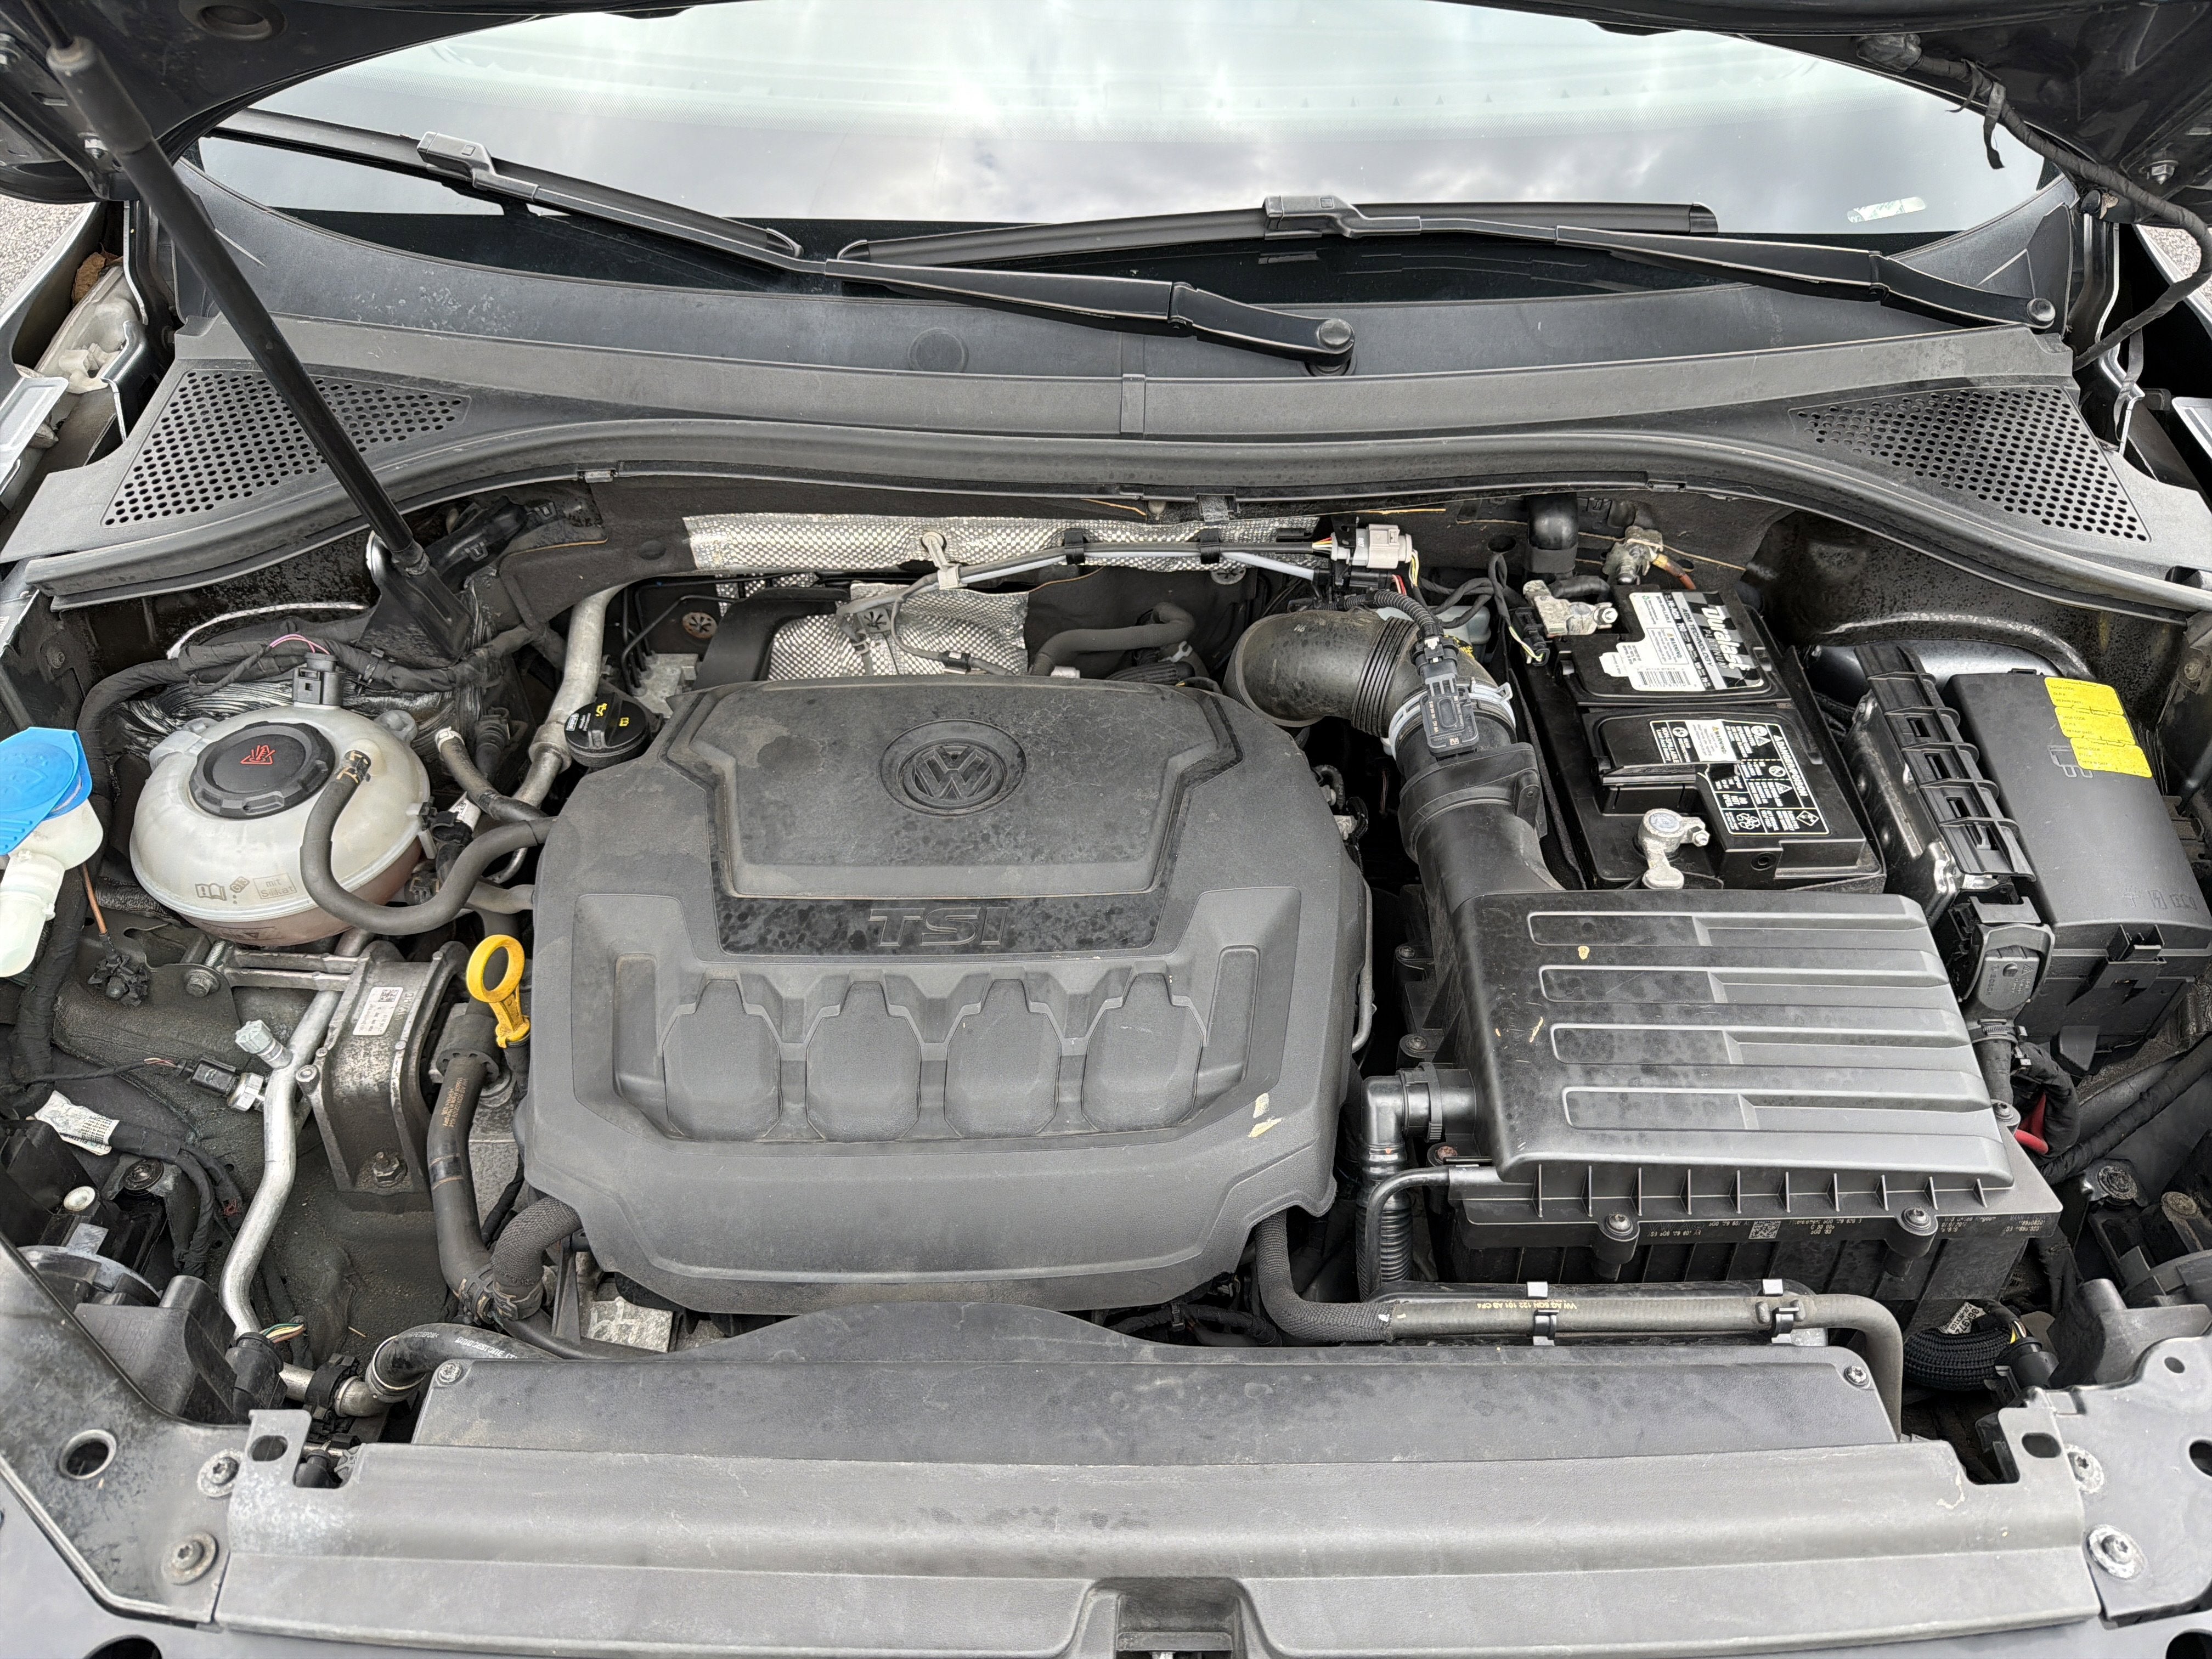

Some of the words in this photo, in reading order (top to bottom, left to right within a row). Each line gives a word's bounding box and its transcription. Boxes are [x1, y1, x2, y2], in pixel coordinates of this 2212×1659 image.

[1681, 608, 1692, 622] AGM
[1688, 624, 1713, 667] TECHNOLOGY
[1700, 606, 1751, 670] Duralast
[1702, 629, 1728, 668] PLATINUM
[1661, 727, 1680, 763] NON-SPILLABLE
[1775, 741, 1808, 795] DANGER/POISON
[868, 906, 1009, 946] TSI
[455, 1336, 506, 1357] BRIDGESTONE
